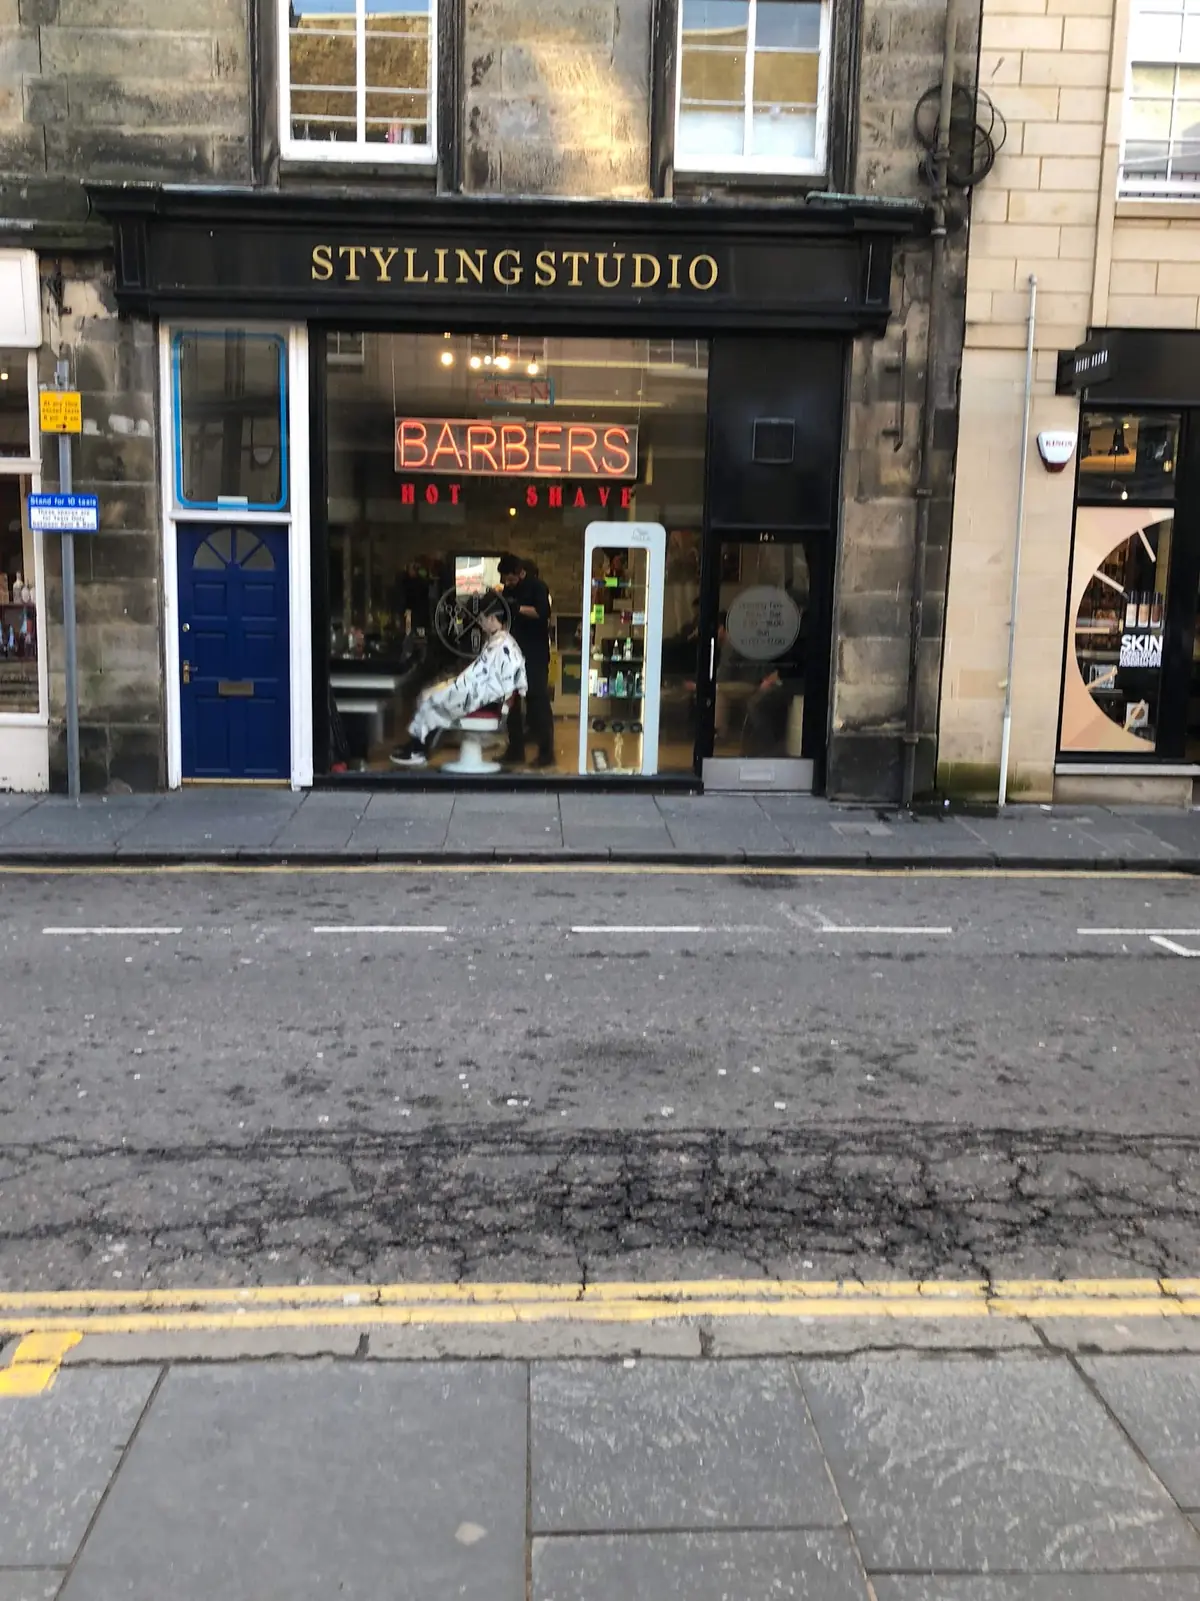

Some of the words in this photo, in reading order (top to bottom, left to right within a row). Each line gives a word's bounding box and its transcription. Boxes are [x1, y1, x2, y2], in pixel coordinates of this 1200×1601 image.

[311, 244, 524, 285] STYLING
[534, 248, 719, 290] STUDIO
[397, 420, 630, 474] BARBERS
[30, 496, 52, 505] Stand
[54, 497, 64, 505] for
[67, 497, 76, 505] 10
[78, 497, 96, 506] taxis
[401, 483, 461, 505] HOT
[526, 485, 631, 509] SHAVE
[1120, 634, 1163, 652] SKIN
